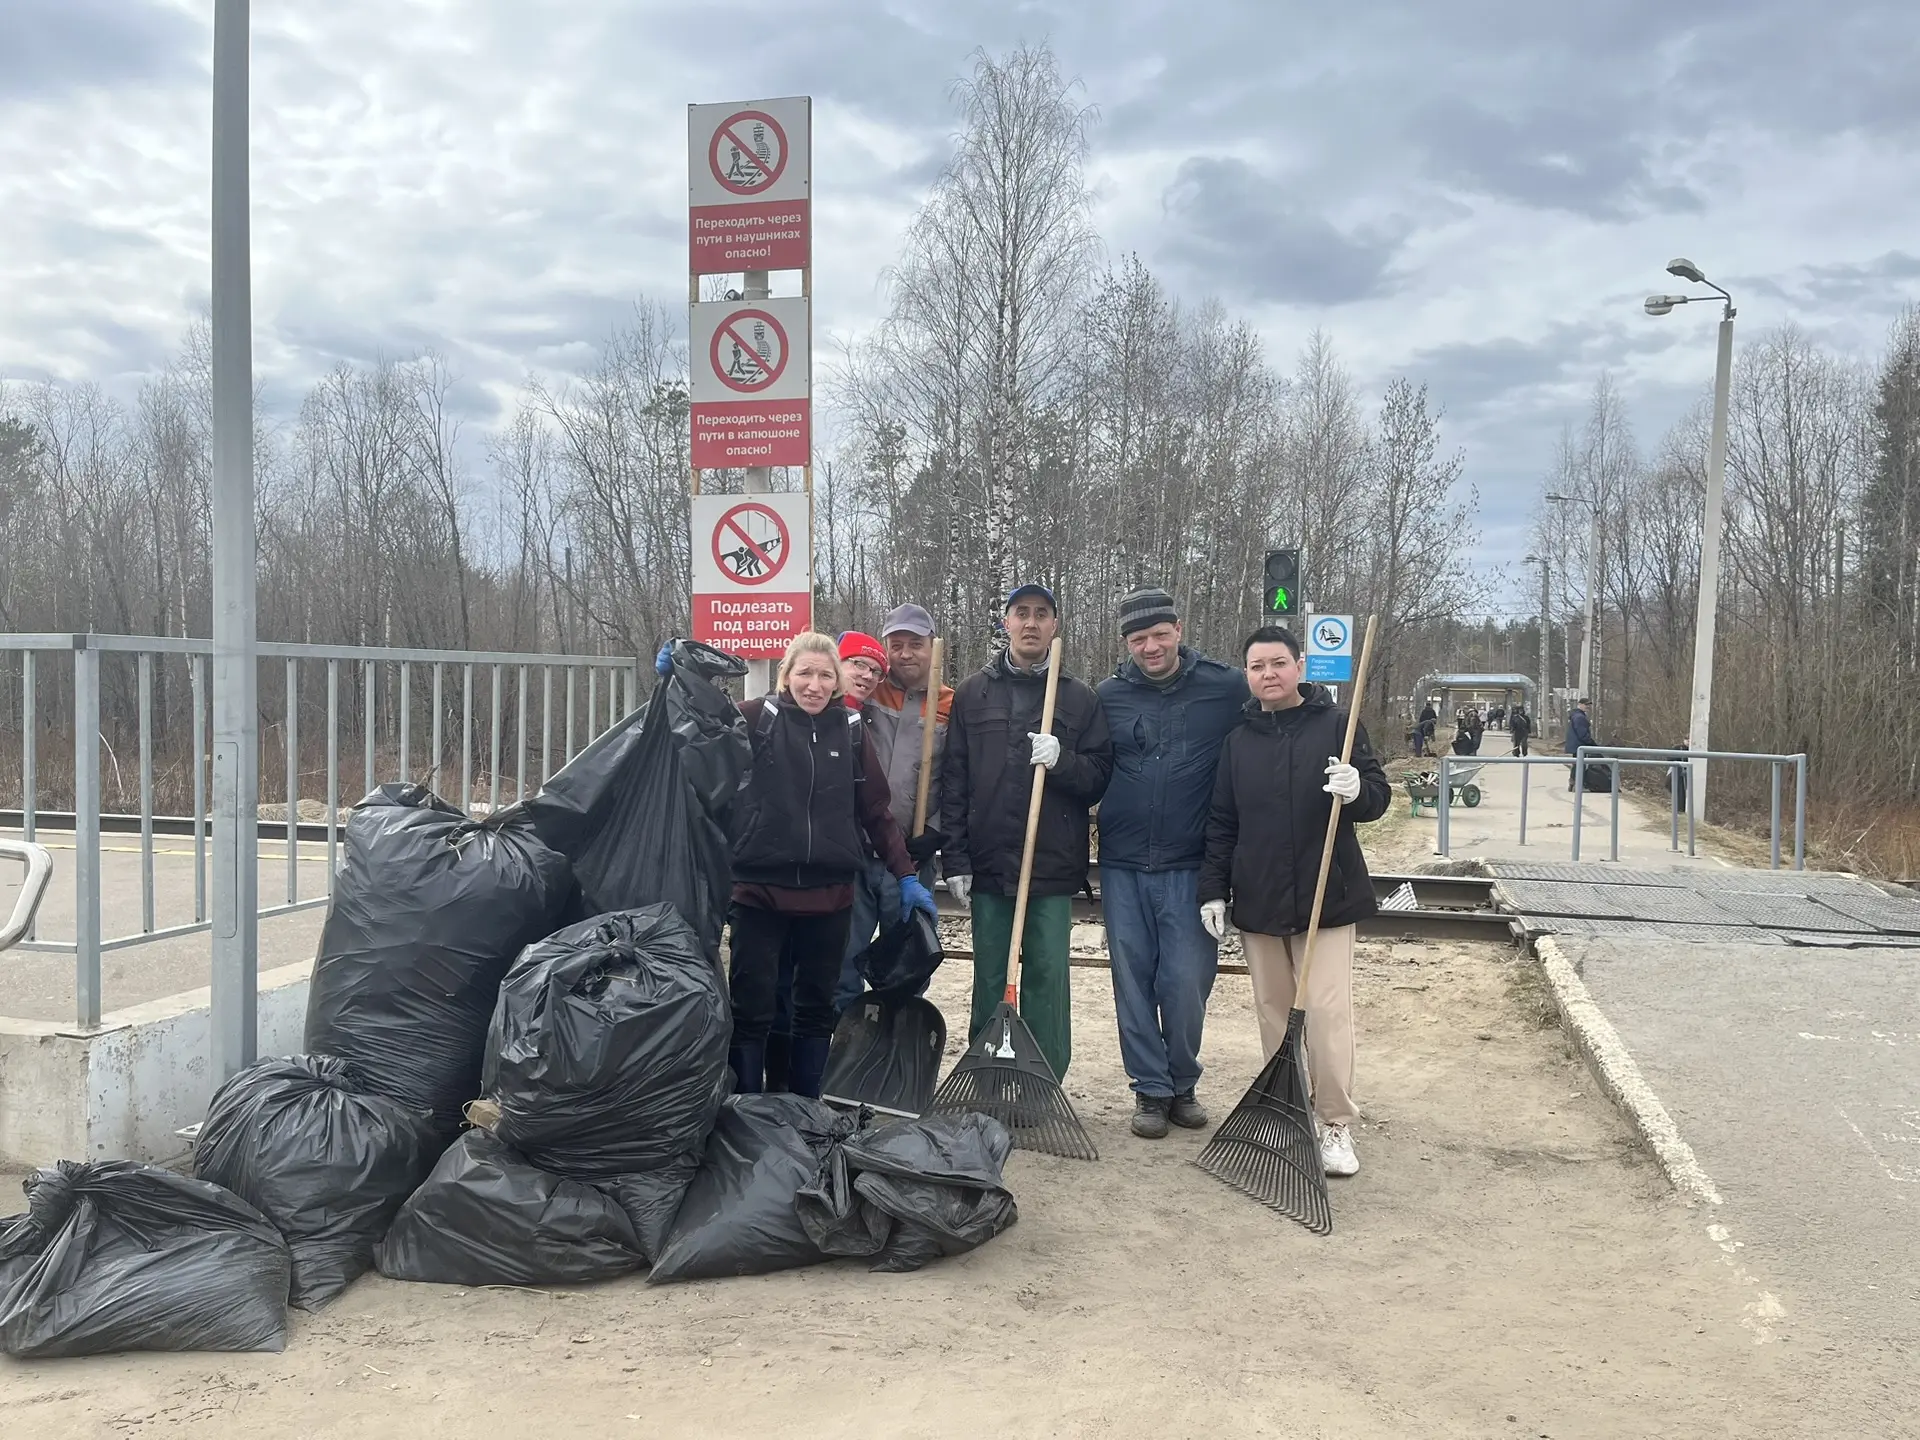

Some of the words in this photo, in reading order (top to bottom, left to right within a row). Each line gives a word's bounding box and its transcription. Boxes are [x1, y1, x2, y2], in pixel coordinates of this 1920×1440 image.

[695, 217, 765, 230] Переходить
[768, 214, 802, 225] через
[696, 235, 722, 246] пути
[726, 234, 732, 243] в
[735, 230, 801, 244] наушниках
[725, 245, 771, 259] опасно!
[697, 414, 766, 427] Переходить
[768, 413, 802, 424] через
[699, 431, 725, 443] пути
[728, 431, 734, 440] в
[738, 428, 800, 440] капюшоне
[726, 443, 772, 456] опасно!
[711, 600, 793, 616] Подлезать
[713, 620, 743, 634] под
[746, 620, 790, 631] вагон
[705, 635, 796, 652] запрещено
